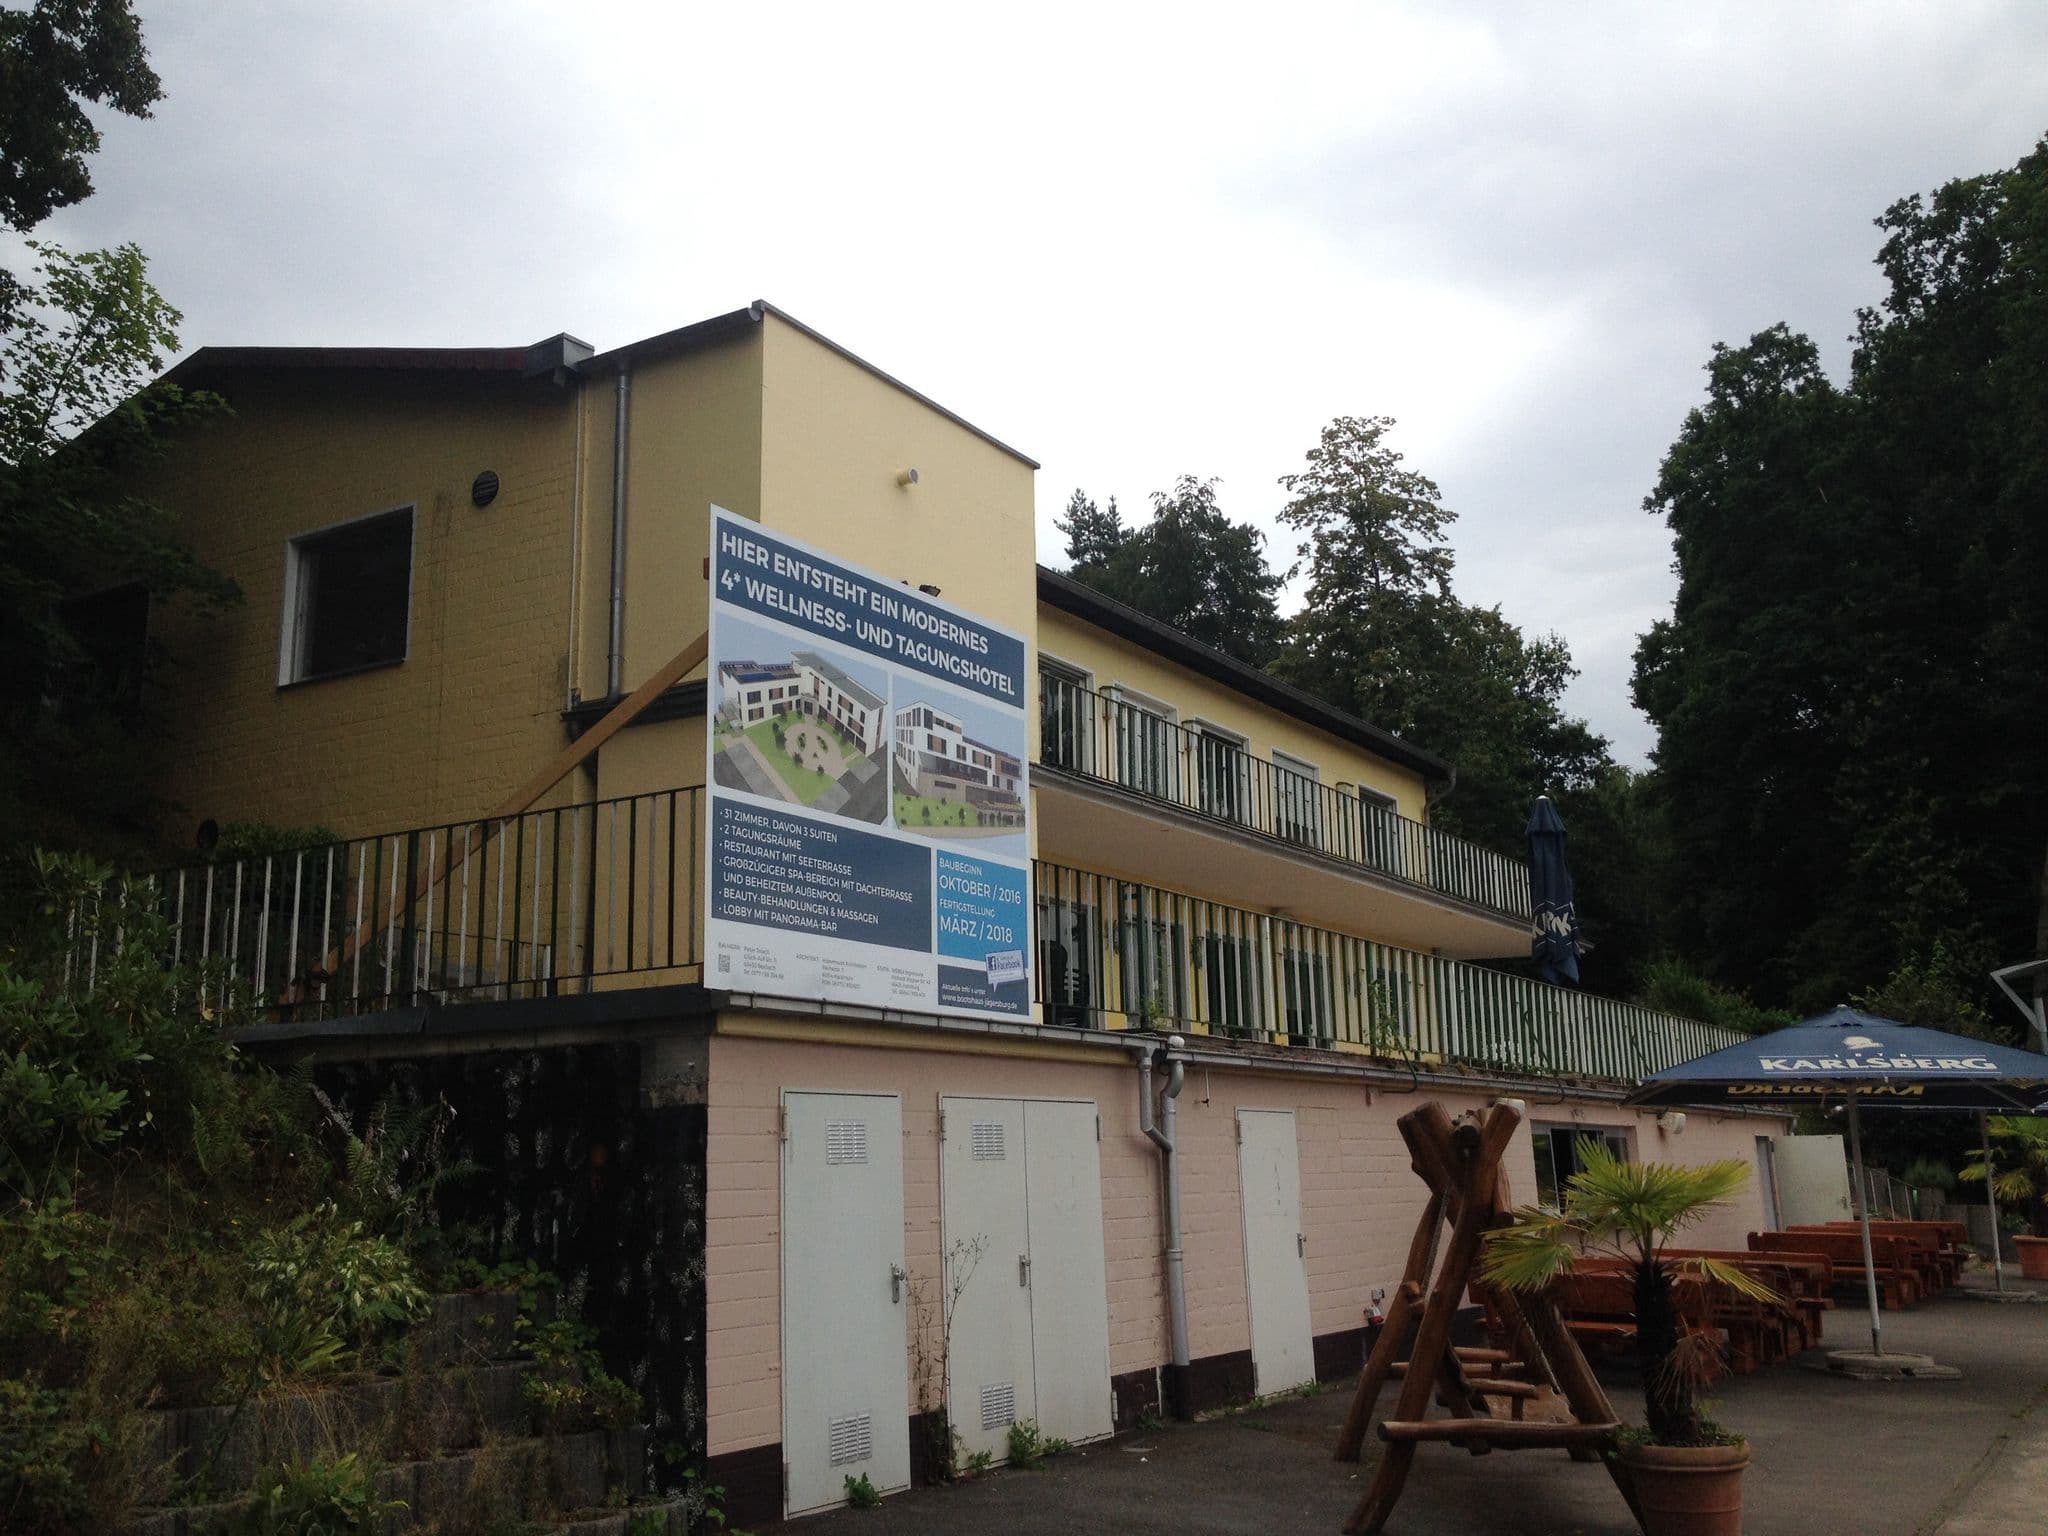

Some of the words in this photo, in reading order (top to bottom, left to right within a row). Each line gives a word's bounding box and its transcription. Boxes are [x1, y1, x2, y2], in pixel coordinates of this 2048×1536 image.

[722, 531, 769, 569] HIER
[774, 552, 868, 606] ENTSTEHT
[871, 591, 899, 620] EIN
[902, 604, 988, 655] MODERNES
[745, 576, 852, 632] WELLNESS-
[856, 618, 893, 649] UND
[896, 634, 1016, 696] TAGUNGSHOTEL
[724, 808, 733, 819] 31
[772, 819, 803, 836] DAVON
[803, 826, 809, 837] 3
[809, 829, 838, 844] SUITEN
[724, 824, 730, 835] 2
[731, 825, 802, 851] TAGUNGSRÄUME
[724, 839, 781, 861] RESTAURANT
[782, 853, 798, 864] MIT
[798, 855, 853, 876] SEETERRASSE
[939, 857, 983, 877] BAUBEGINN
[723, 855, 786, 879] GROßZÜGIGER
[787, 868, 840, 888] SPA-BEREICH
[841, 879, 855, 891] MIT
[855, 882, 913, 903] DACHTERRASSE
[723, 871, 744, 885] UND
[745, 876, 794, 895] BEHEIZTEM
[794, 886, 844, 904] AUßENPOOL
[939, 874, 991, 898] OKTOBER
[998, 887, 1022, 905] 2016
[723, 887, 829, 917] BEAUTY-BEHANDLUNGEN
[830, 907, 836, 917] &
[837, 908, 879, 925] MASSAGEN
[723, 903, 752, 918] LOBBY
[754, 909, 769, 921] MIT
[770, 911, 838, 932] PANORAMA-BAR
[939, 898, 996, 918] FERTIGSTELLUNG
[940, 913, 977, 938] MÄRZ
[986, 924, 1013, 944] 2018
[997, 959, 1021, 970] Facebook
[1759, 1057, 1998, 1071] KARLSBERG
